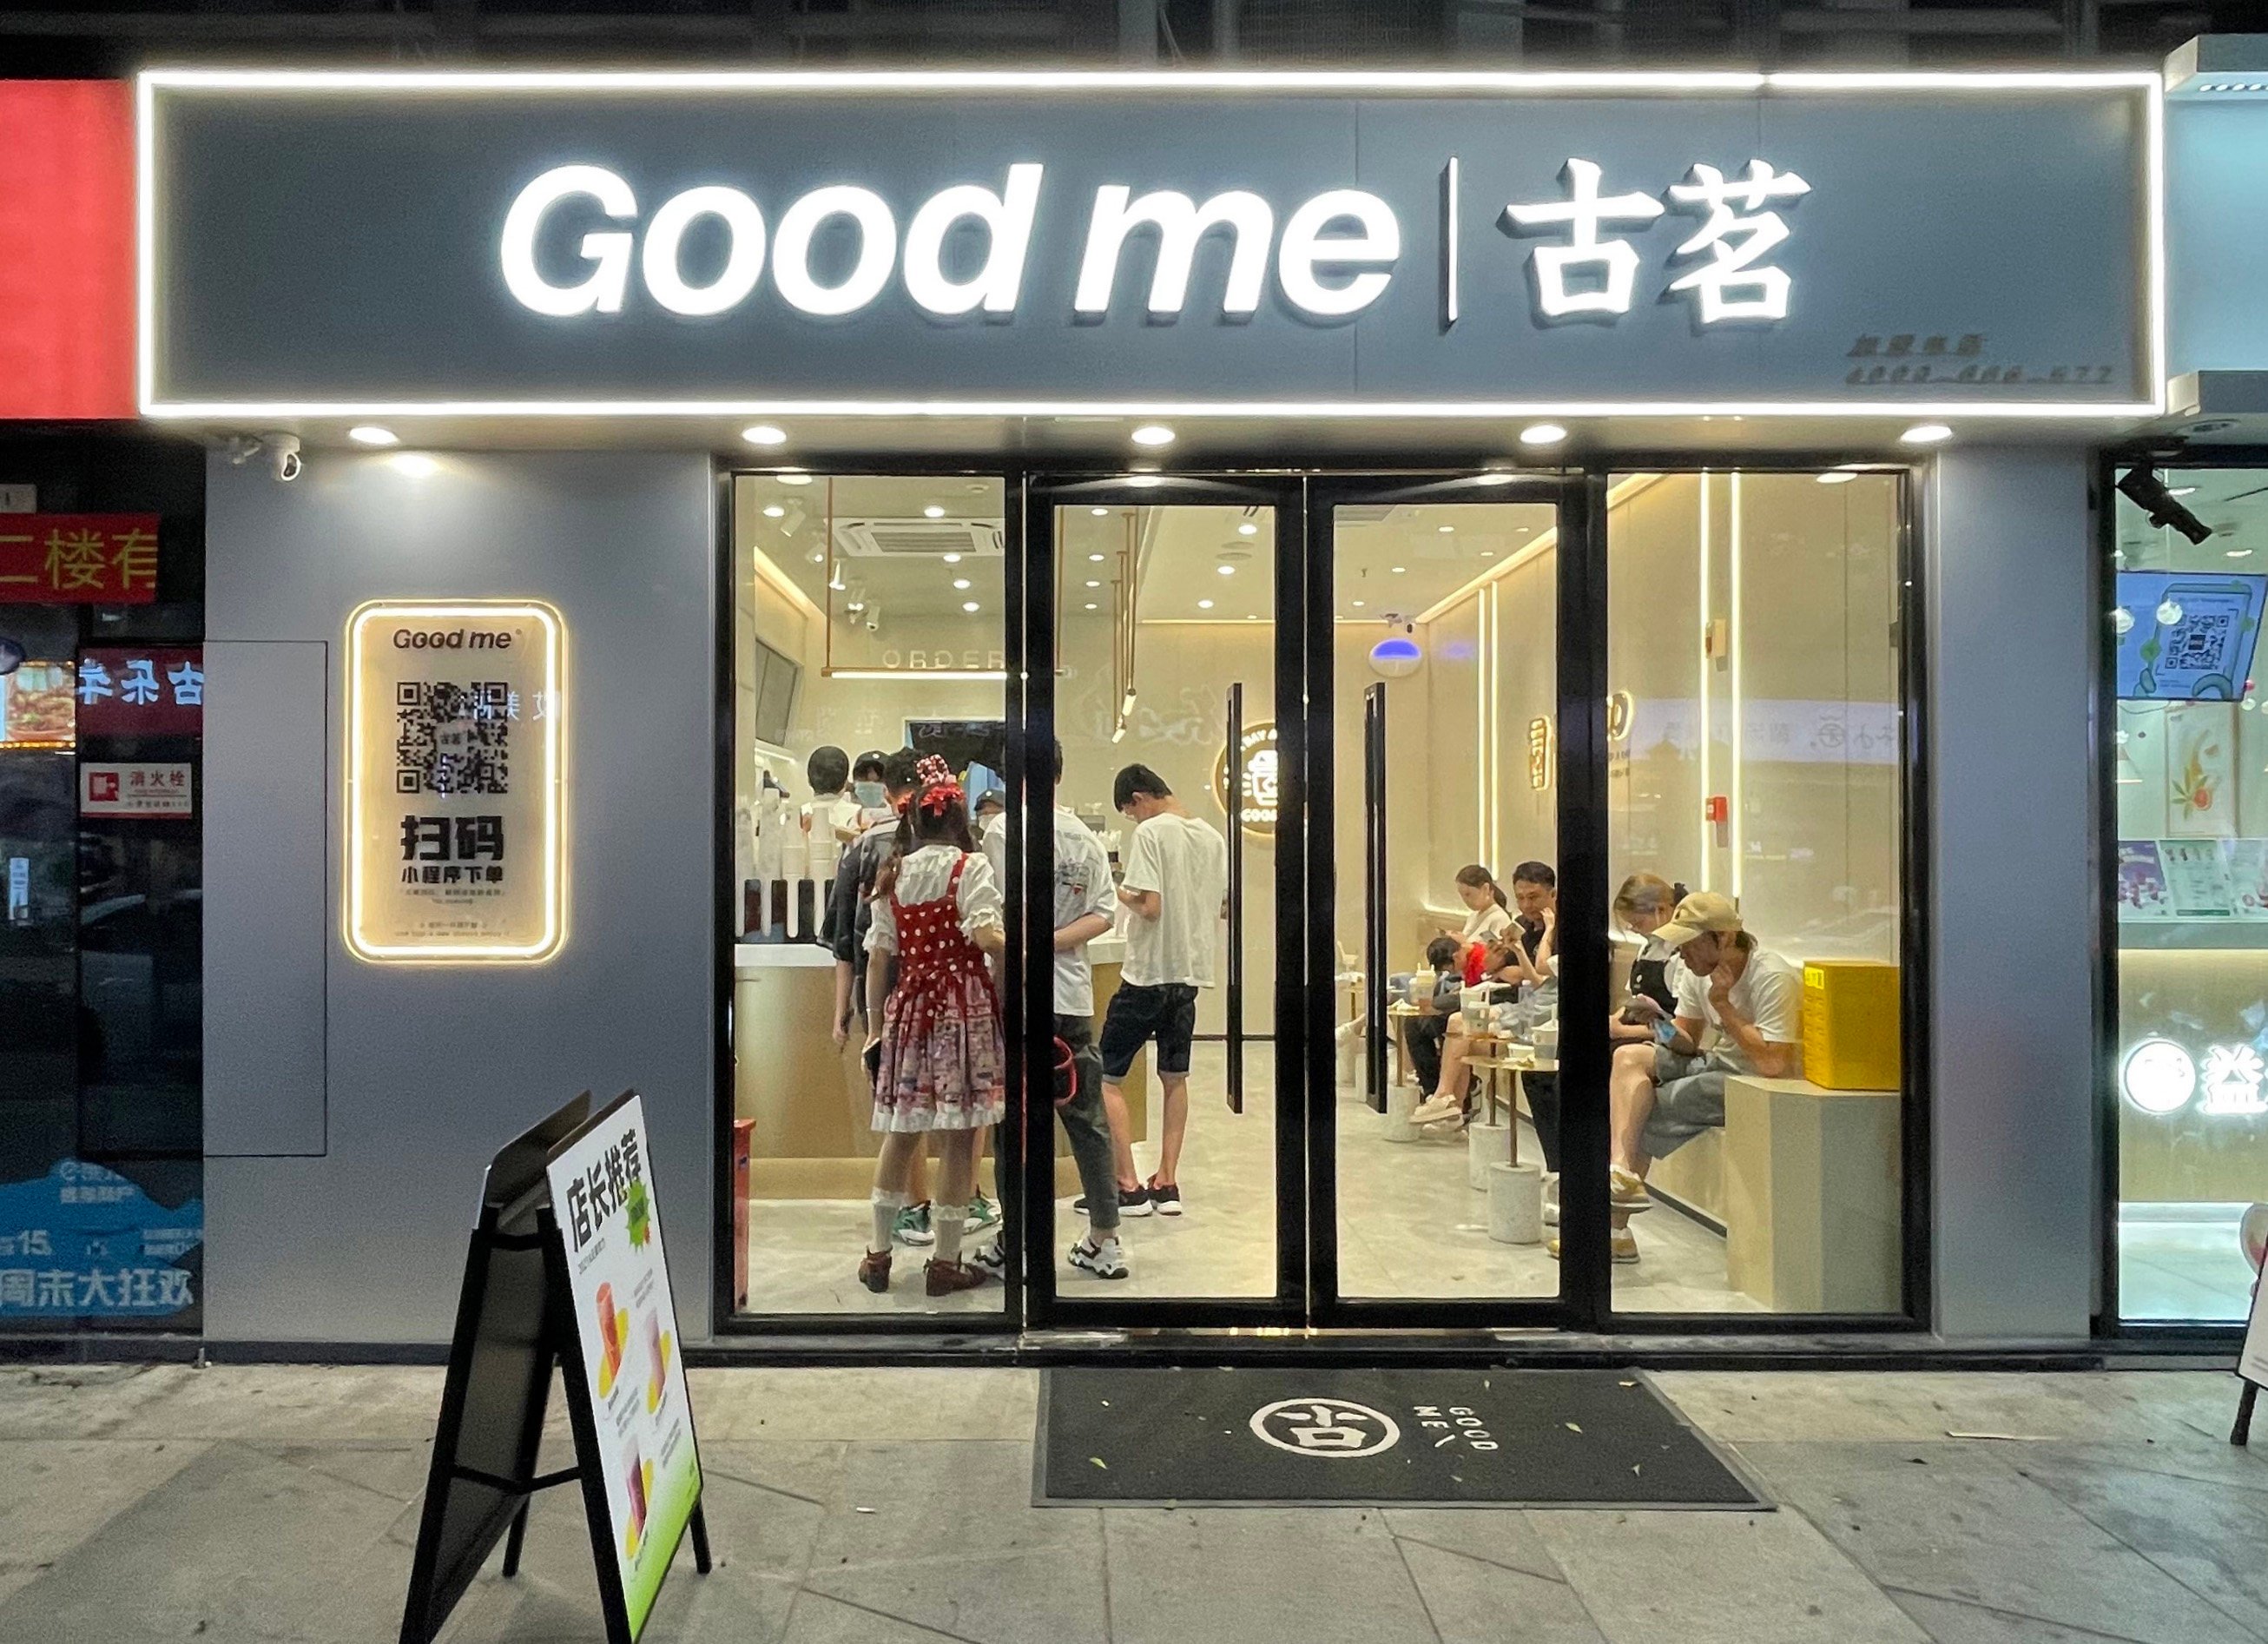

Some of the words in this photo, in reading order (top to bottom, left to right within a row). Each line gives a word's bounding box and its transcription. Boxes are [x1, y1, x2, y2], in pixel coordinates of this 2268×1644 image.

[500, 162, 1045, 316] Good
[1074, 184, 1401, 315] me
[1505, 158, 1812, 323] 古茗
[393, 628, 465, 650] Good
[468, 631, 512, 650] me
[881, 649, 1005, 670] ORDER
[400, 815, 504, 861] 扫码
[401, 866, 504, 884] 小程序下单
[566, 1128, 642, 1252] 店长推荐
[1448, 1406, 1499, 1450] GOOD
